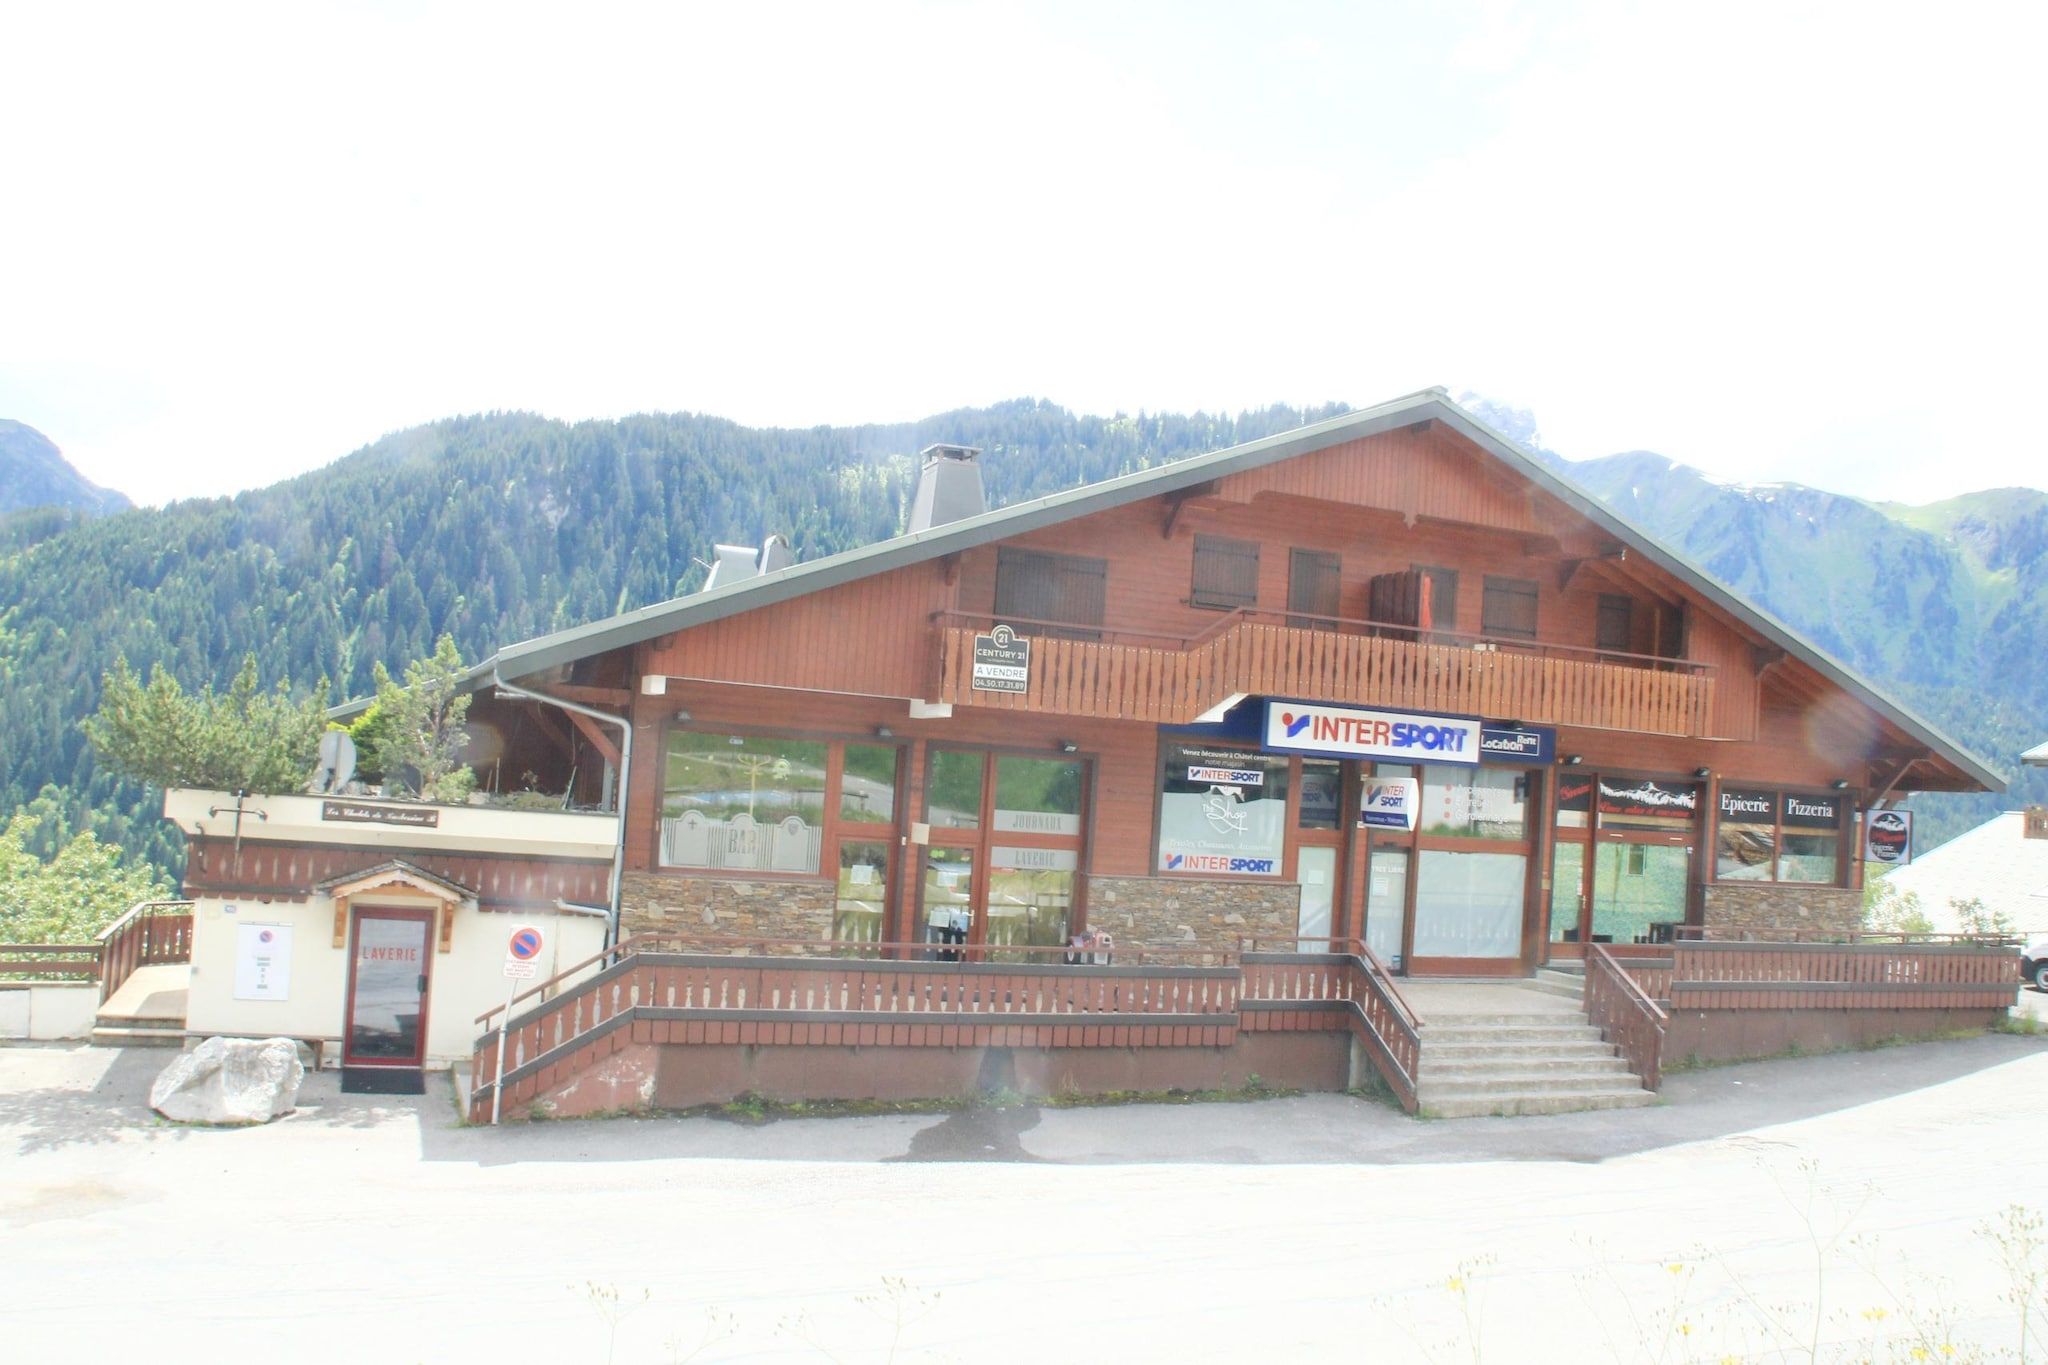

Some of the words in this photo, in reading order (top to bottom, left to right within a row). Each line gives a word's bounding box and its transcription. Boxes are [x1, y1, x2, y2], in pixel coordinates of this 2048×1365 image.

[998, 633, 1008, 643] 21
[976, 648, 1016, 660] CENTURY
[1017, 652, 1026, 660] 21
[976, 666, 983, 675] A
[986, 667, 1025, 679] VENDRE
[1312, 714, 1468, 752] INTERSPORT
[1480, 734, 1524, 752] Location
[1517, 735, 1537, 746] Rent
[1182, 748, 1201, 758] Venez
[1201, 769, 1260, 783] INTERSPORT
[1382, 785, 1404, 796] INTER
[1380, 796, 1403, 808] SPORT
[1720, 793, 1769, 816] Epicerie
[1787, 798, 1833, 818] Pizzeria
[1013, 814, 1062, 831] JOURNAUX
[1206, 798, 1248, 836] Shop
[728, 828, 757, 855] BAR
[1015, 850, 1055, 867] LAVERIE
[1184, 855, 1273, 873] INTERSPORT
[363, 945, 417, 961] LAVERIE
